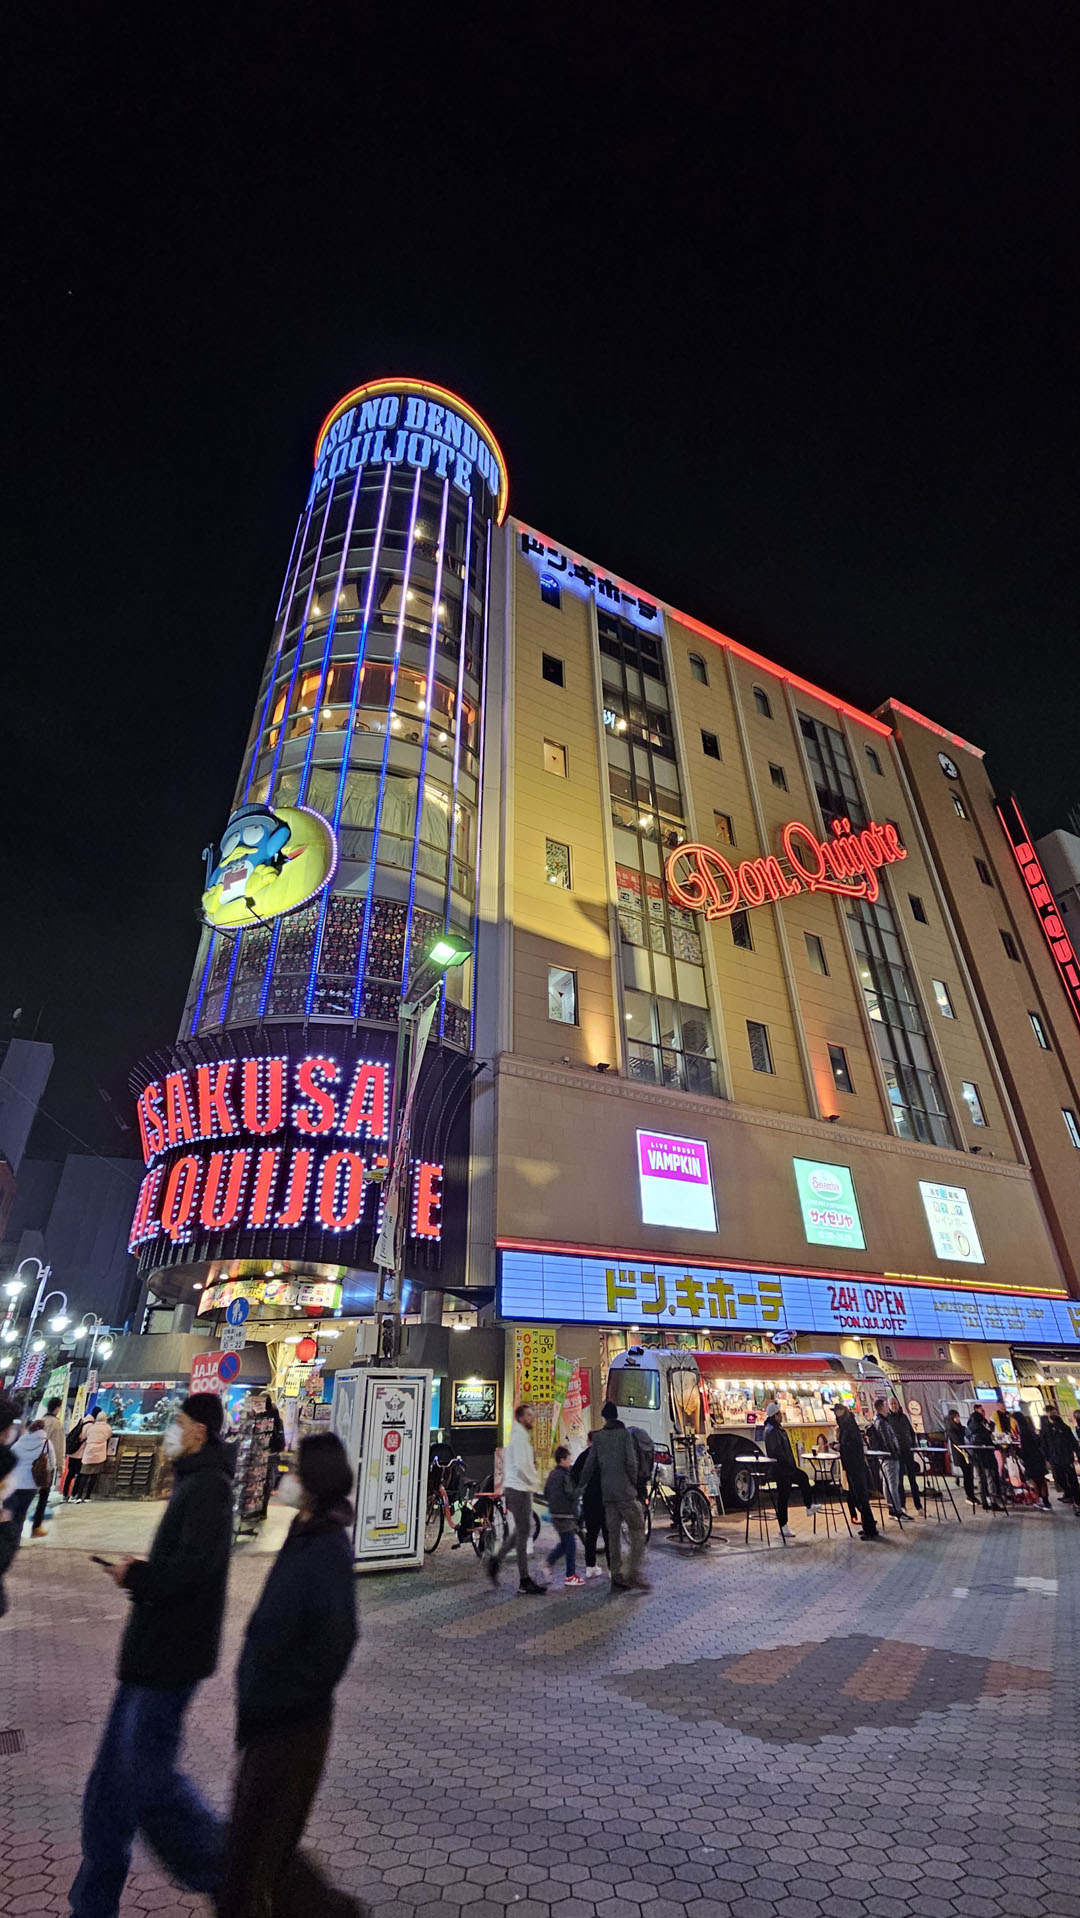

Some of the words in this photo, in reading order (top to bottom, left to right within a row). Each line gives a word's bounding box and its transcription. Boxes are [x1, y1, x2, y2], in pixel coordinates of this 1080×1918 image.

[357, 396, 399, 433] NO
[651, 1141, 668, 1151] LIVE
[647, 1149, 702, 1178] VAMPKIN
[809, 1208, 854, 1229] サイゼリヤ
[827, 1286, 859, 1312] 24H
[865, 1289, 906, 1315] OPEN
[933, 1301, 983, 1314] AMUSEMENT
[986, 1305, 1024, 1317] DISCOUNT
[1026, 1308, 1044, 1319] SHOP
[962, 1316, 980, 1328] TAX
[985, 1317, 1005, 1329] FREE
